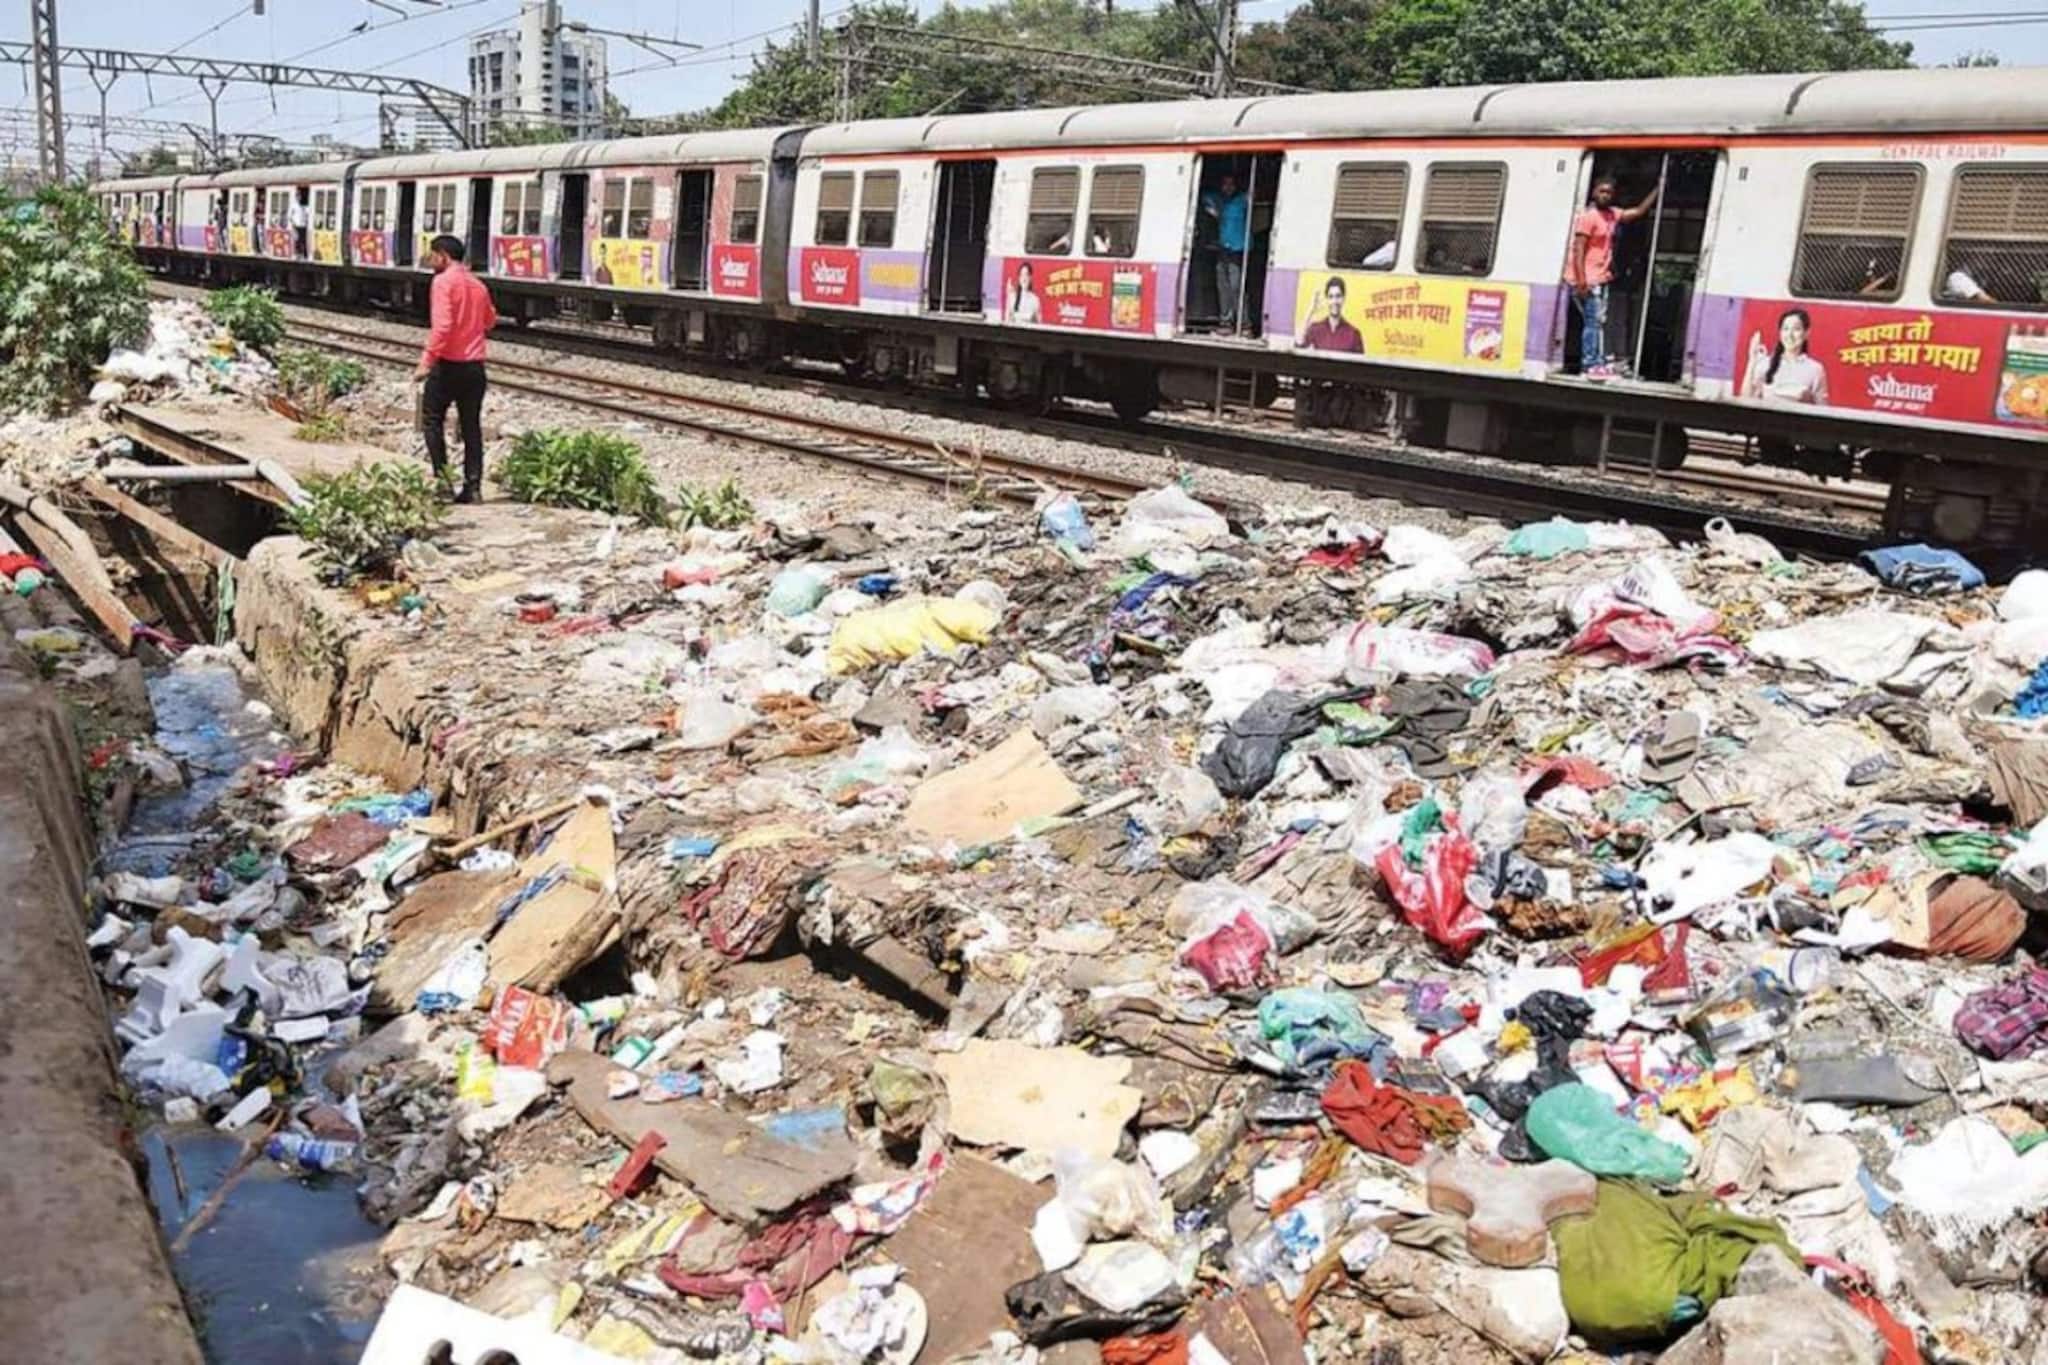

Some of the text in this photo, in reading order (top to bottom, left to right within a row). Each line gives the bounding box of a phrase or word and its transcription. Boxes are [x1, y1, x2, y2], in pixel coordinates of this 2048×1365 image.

[1881, 143, 2007, 160] CENTRAL RAILWAY
[1849, 314, 1934, 344] खाया तो
[1887, 343, 1921, 365] आ
[1923, 343, 1982, 373] गया!
[1868, 372, 1937, 402] Suhana
